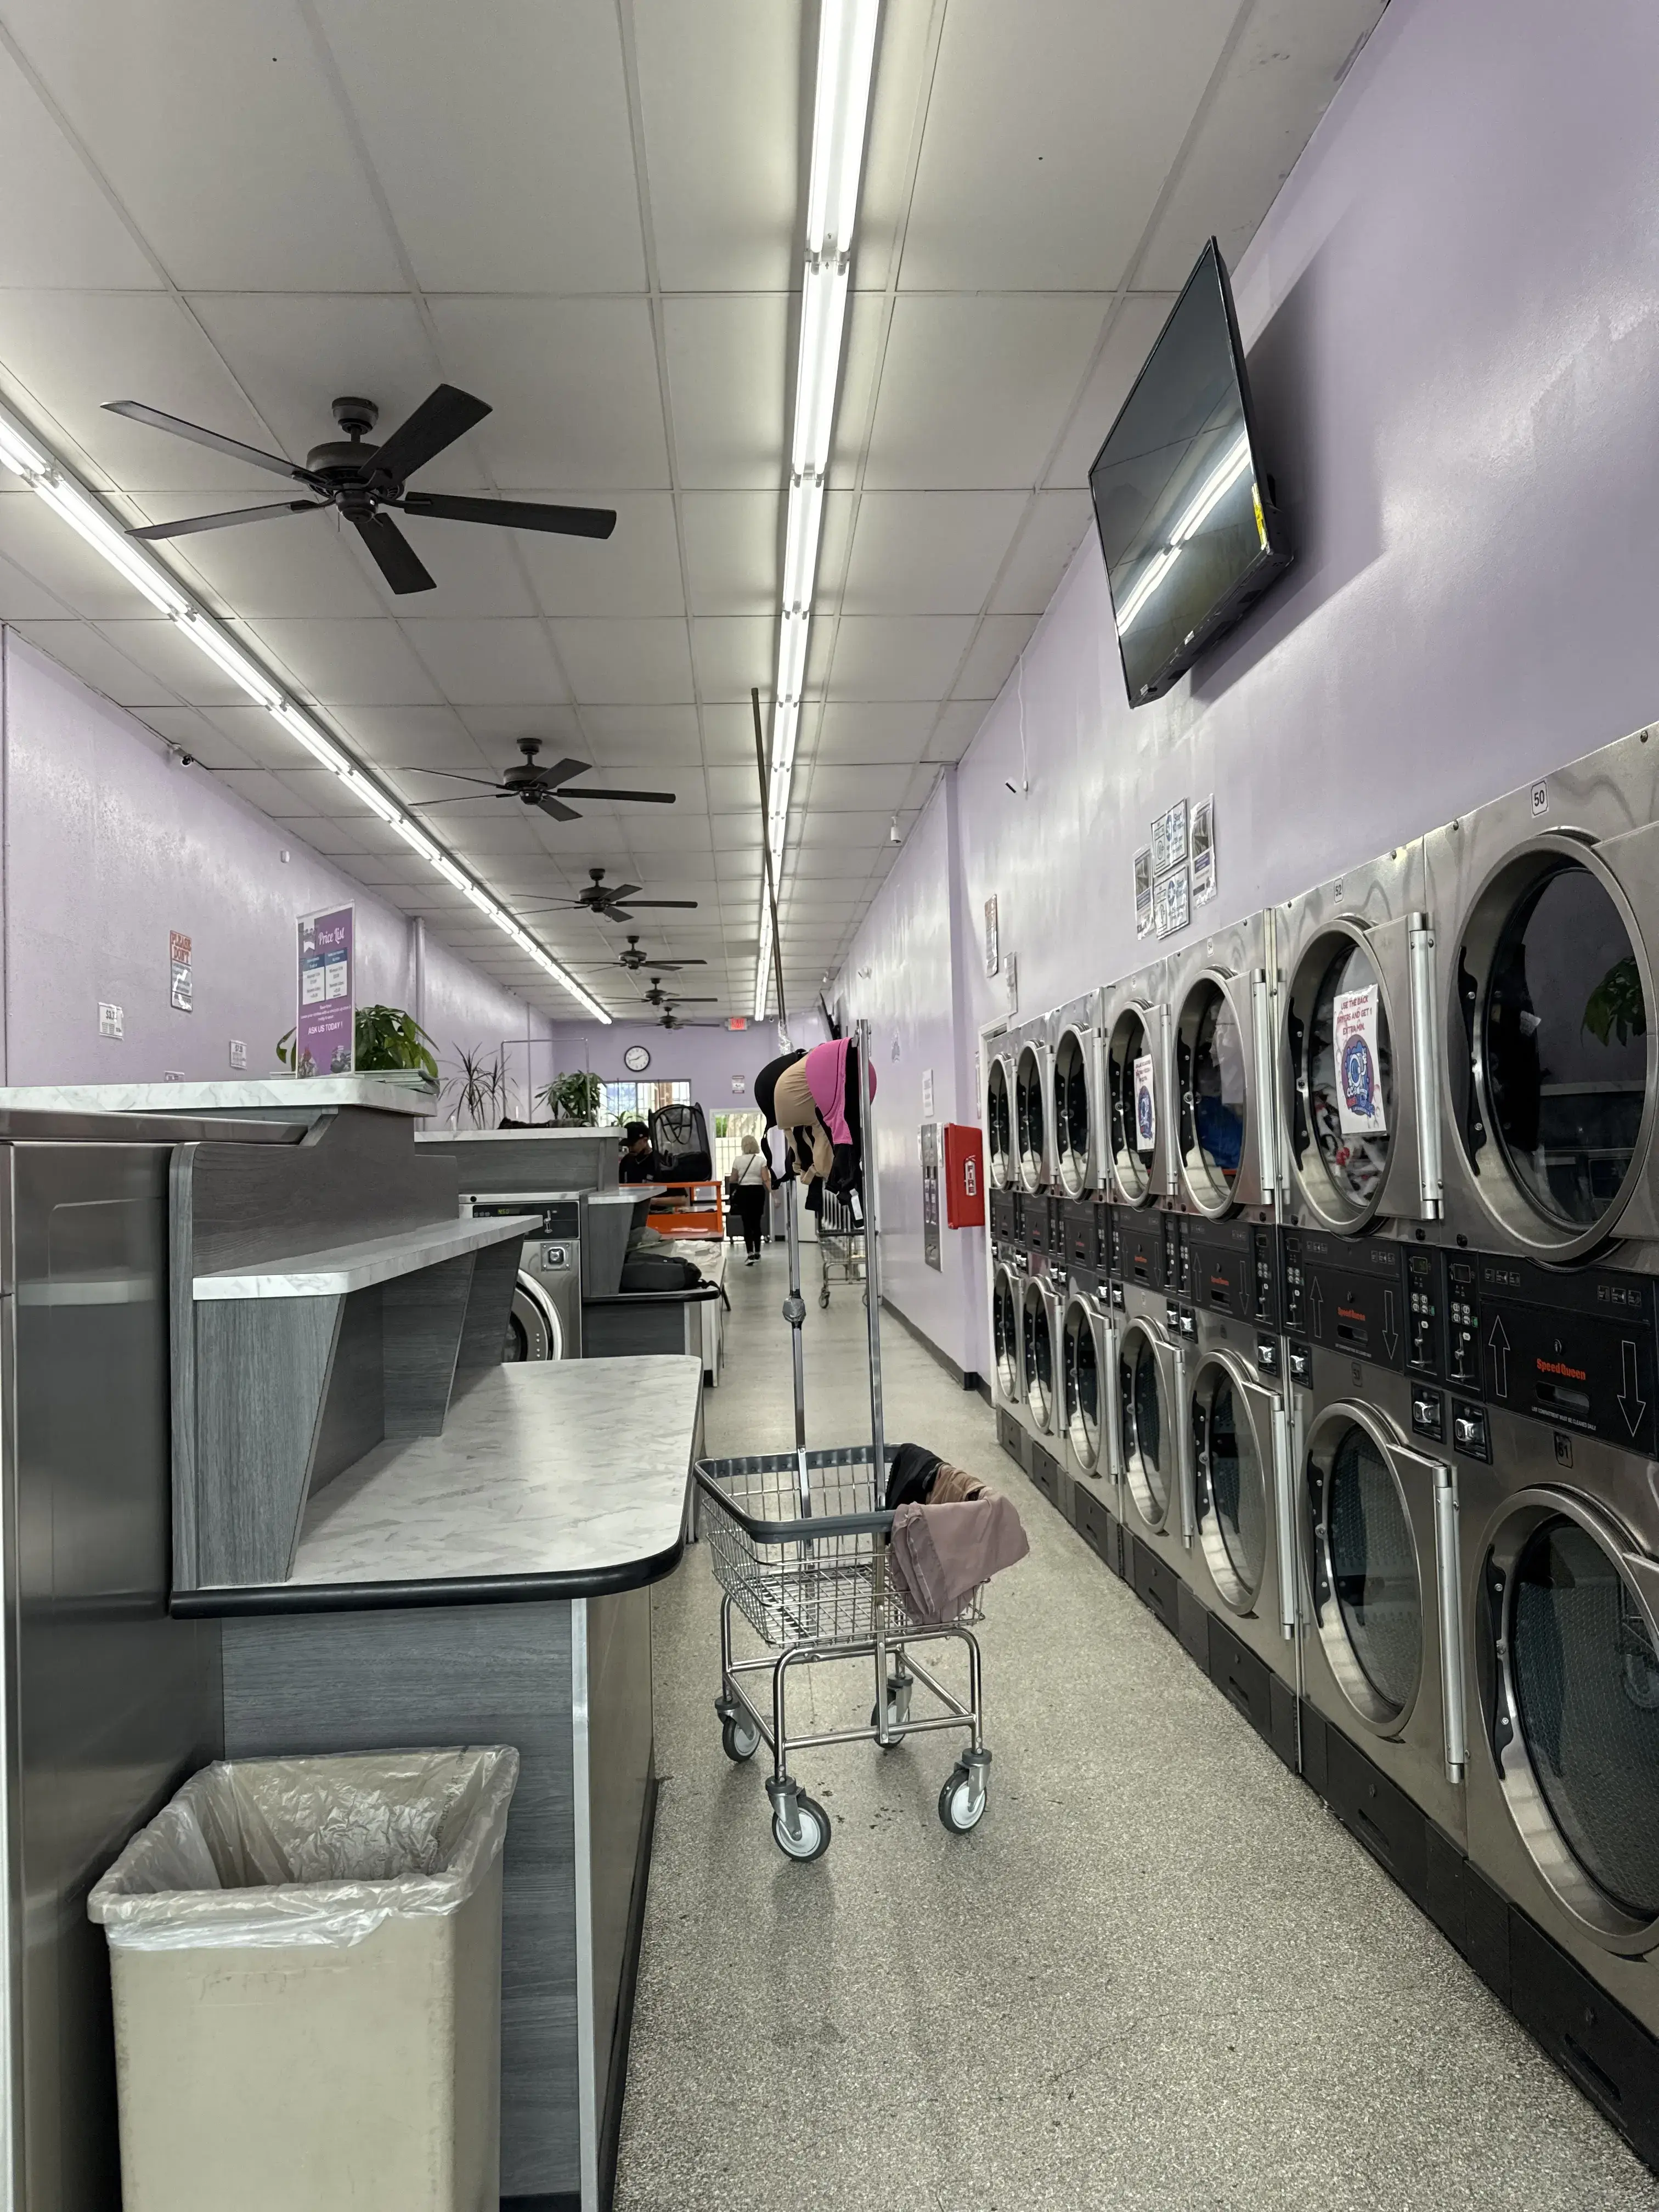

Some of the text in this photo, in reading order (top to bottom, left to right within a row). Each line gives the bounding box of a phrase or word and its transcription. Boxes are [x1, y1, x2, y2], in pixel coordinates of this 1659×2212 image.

[1534, 789, 1545, 807] 50
[1335, 884, 1342, 897] 52
[318, 927, 345, 946] Price List
[1357, 996, 1368, 1006] BACK
[1352, 1011, 1360, 1019] AND
[1361, 1008, 1369, 1017] GET
[308, 1026, 318, 1035] ASK
[318, 1024, 325, 1032] US
[325, 1022, 340, 1031] TODAY
[1342, 1025, 1357, 1035] EXTRA
[1537, 1358, 1586, 1381] Speed Queen
[1558, 1441, 1569, 1459] 51
